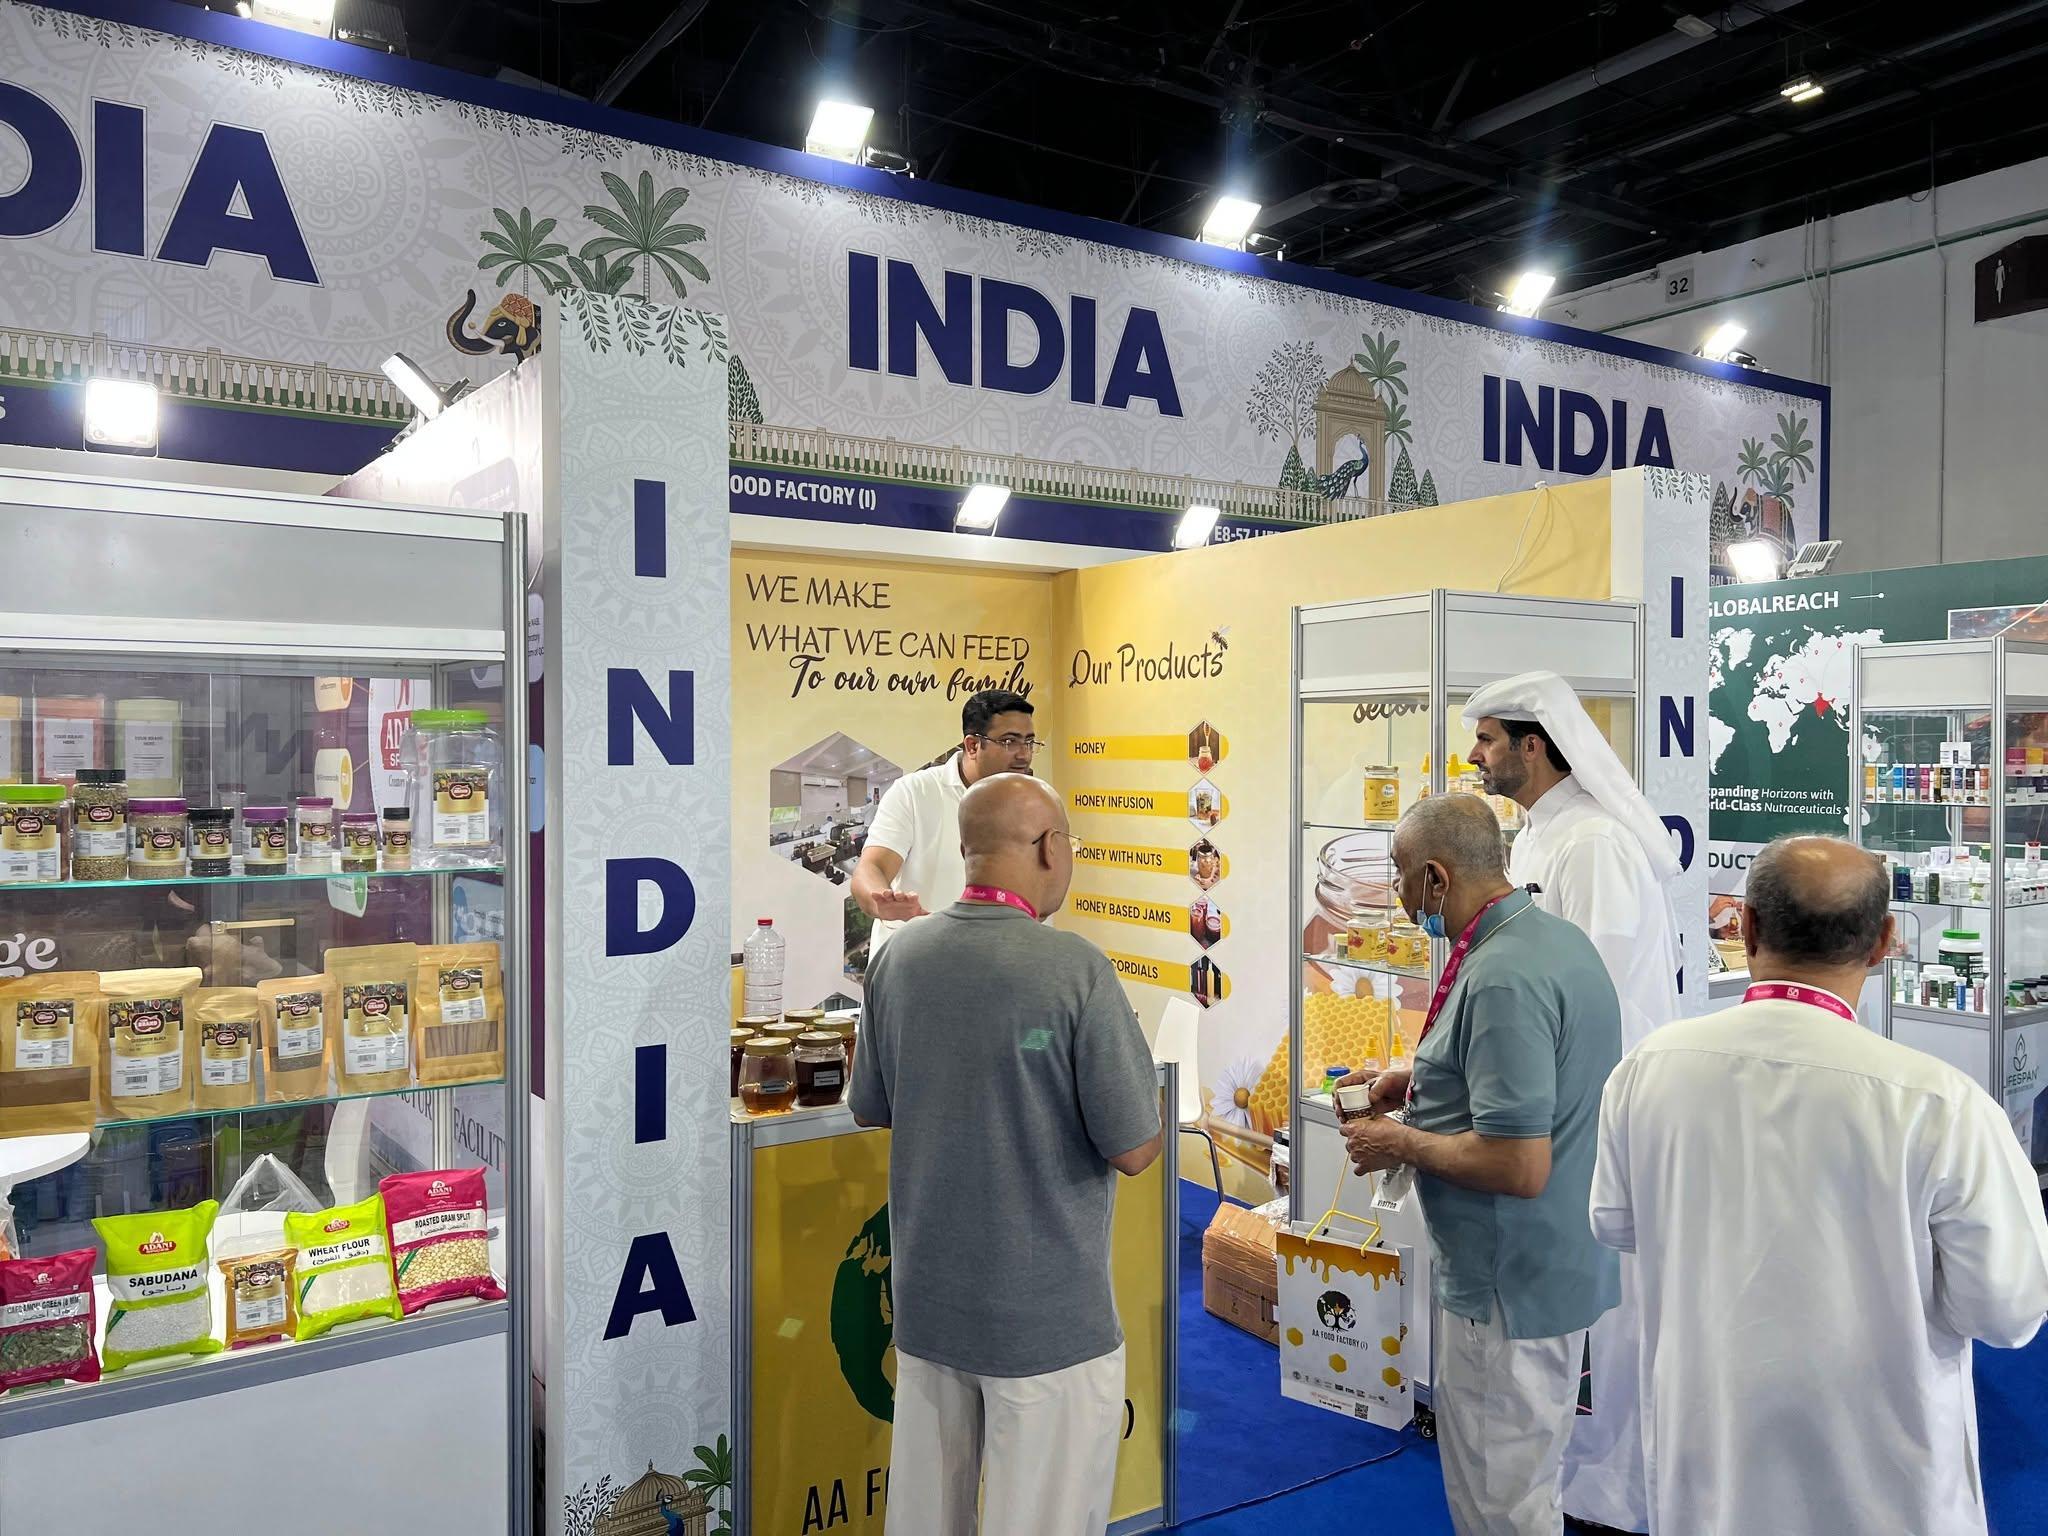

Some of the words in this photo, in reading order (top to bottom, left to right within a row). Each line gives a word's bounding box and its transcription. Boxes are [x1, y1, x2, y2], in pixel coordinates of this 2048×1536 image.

[1670, 277, 1689, 296] 32
[847, 249, 1185, 419] INDIA
[1482, 373, 1675, 476] INDIA
[775, 479, 856, 506] FACTORY
[858, 488, 877, 511] (I)
[1214, 525, 1250, 542] E8-57
[746, 573, 800, 603] WE
[806, 577, 891, 609] MAKE
[746, 623, 840, 654] WHAT
[843, 629, 893, 656] WE
[899, 631, 956, 660] CAN
[963, 634, 1030, 661] FEED
[1072, 649, 1112, 685] Our
[1116, 641, 1224, 683] Products
[789, 654, 826, 699] To
[834, 666, 880, 692] our
[887, 670, 941, 696] own
[946, 660, 1034, 702] family
[1074, 742, 1106, 755] HONEY
[1074, 794, 1106, 807] HONEY
[1108, 795, 1154, 810] INFUSION
[1761, 787, 1808, 800] Horizons
[1810, 789, 1834, 801] with
[1709, 798, 1762, 812] rld-Class
[1764, 802, 1842, 815] Nutraceuticals
[1075, 847, 1107, 861] HONEY
[1109, 849, 1134, 863] WITH
[1135, 852, 1163, 867] NUTS
[602, 478, 698, 1342] INDIA
[1075, 898, 1107, 914] HONEY
[1109, 903, 1141, 919] BASED
[1142, 908, 1172, 924] JAMS
[428, 1186, 453, 1195] ADANI
[415, 1216, 440, 1229] ROASTED
[441, 1214, 456, 1223] GRAM
[456, 1212, 471, 1221] SPLIT
[142, 1241, 173, 1252] ADANI
[308, 1245, 339, 1258] WHEAT
[341, 1238, 370, 1252] FLOUR
[129, 1269, 198, 1288] SABUDANA
[42, 1300, 62, 1309] GREEN
[1320, 1331, 1335, 1342] FOOD
[1336, 1334, 1360, 1348] FACTORY
[801, 1477, 849, 1536] AA
